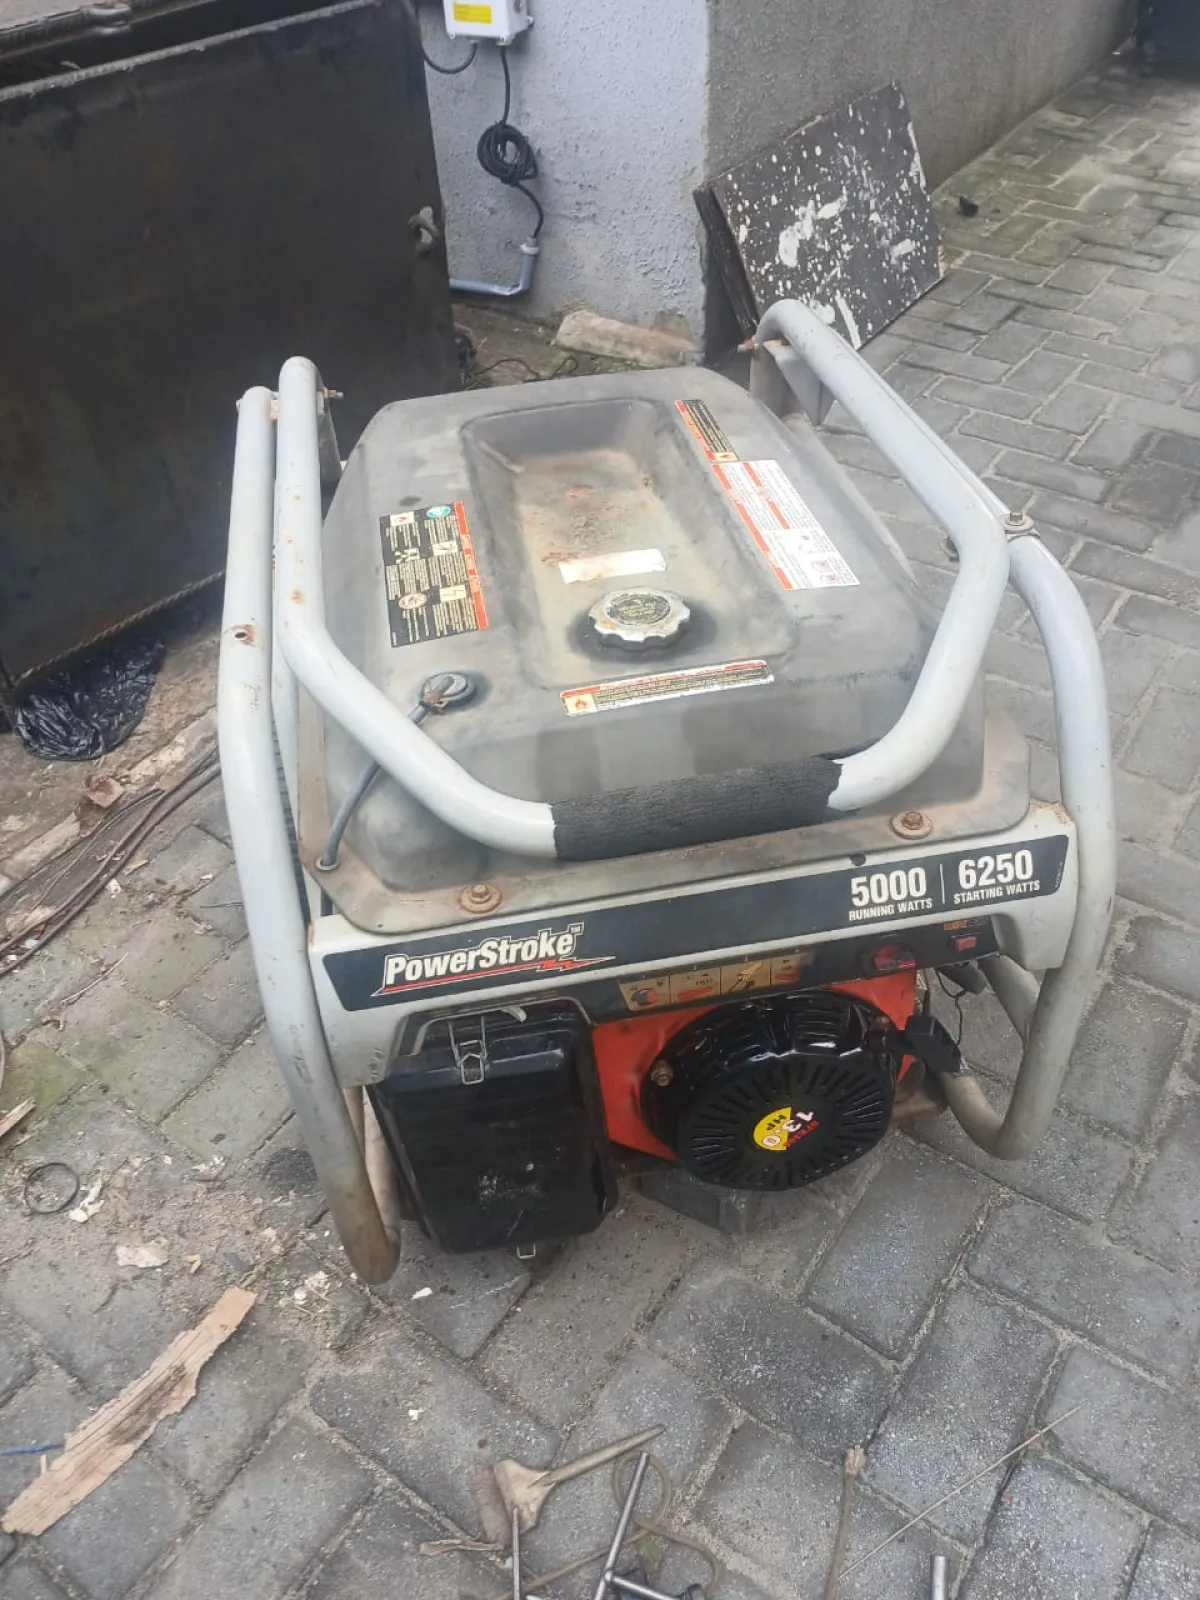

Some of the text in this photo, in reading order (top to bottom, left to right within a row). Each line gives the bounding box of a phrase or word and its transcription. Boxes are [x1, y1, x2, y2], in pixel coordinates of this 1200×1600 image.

[850, 867, 927, 907] 5000
[958, 849, 1034, 890] 6250
[848, 898, 933, 922] RUNNING WATTS
[953, 880, 1041, 905] STARTING WATTS
[385, 931, 573, 984] PowerStroke
[762, 1111, 815, 1147] 13.0
[765, 1114, 786, 1131] HP
